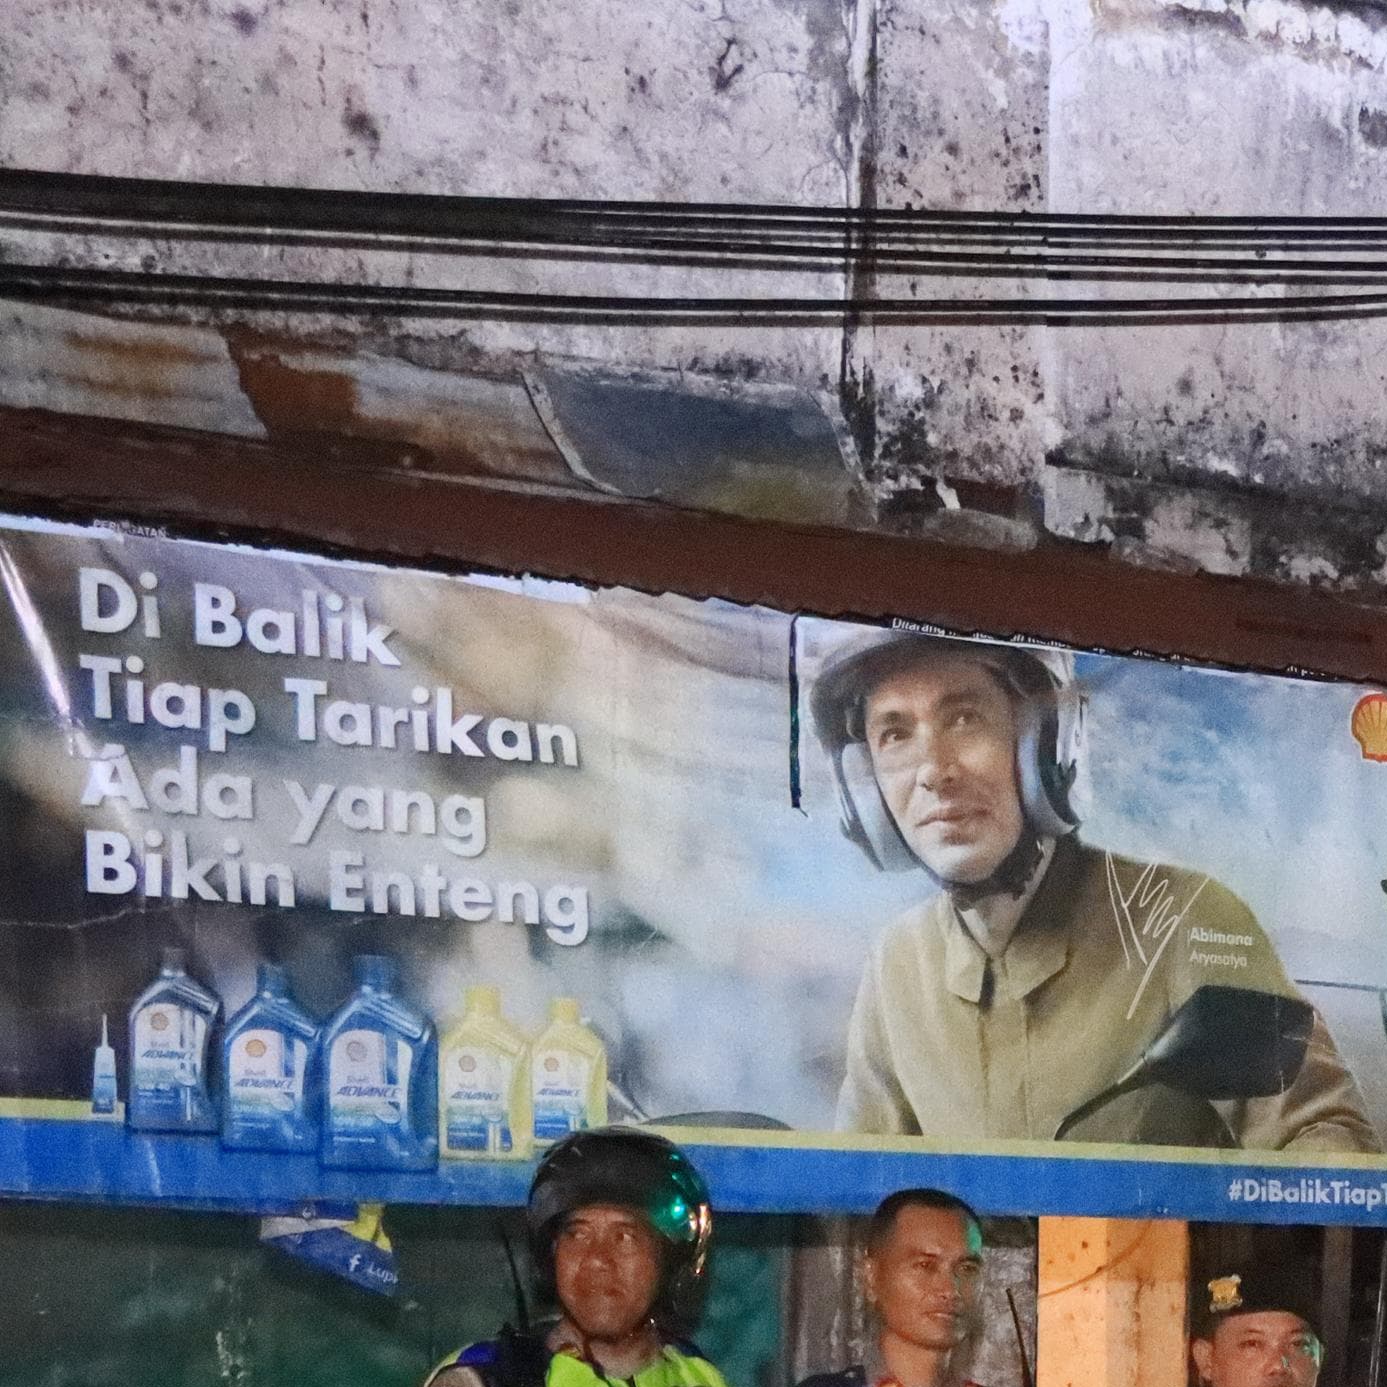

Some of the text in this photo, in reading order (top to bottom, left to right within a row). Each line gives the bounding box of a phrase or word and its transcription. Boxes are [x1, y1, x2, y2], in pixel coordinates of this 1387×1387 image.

[79, 566, 402, 667] Di Balik
[79, 654, 581, 769] Tiap Tarikan
[81, 743, 487, 858] Ada yang
[84, 829, 589, 946] Bikin Enteng
[1191, 927, 1253, 947] Abimana
